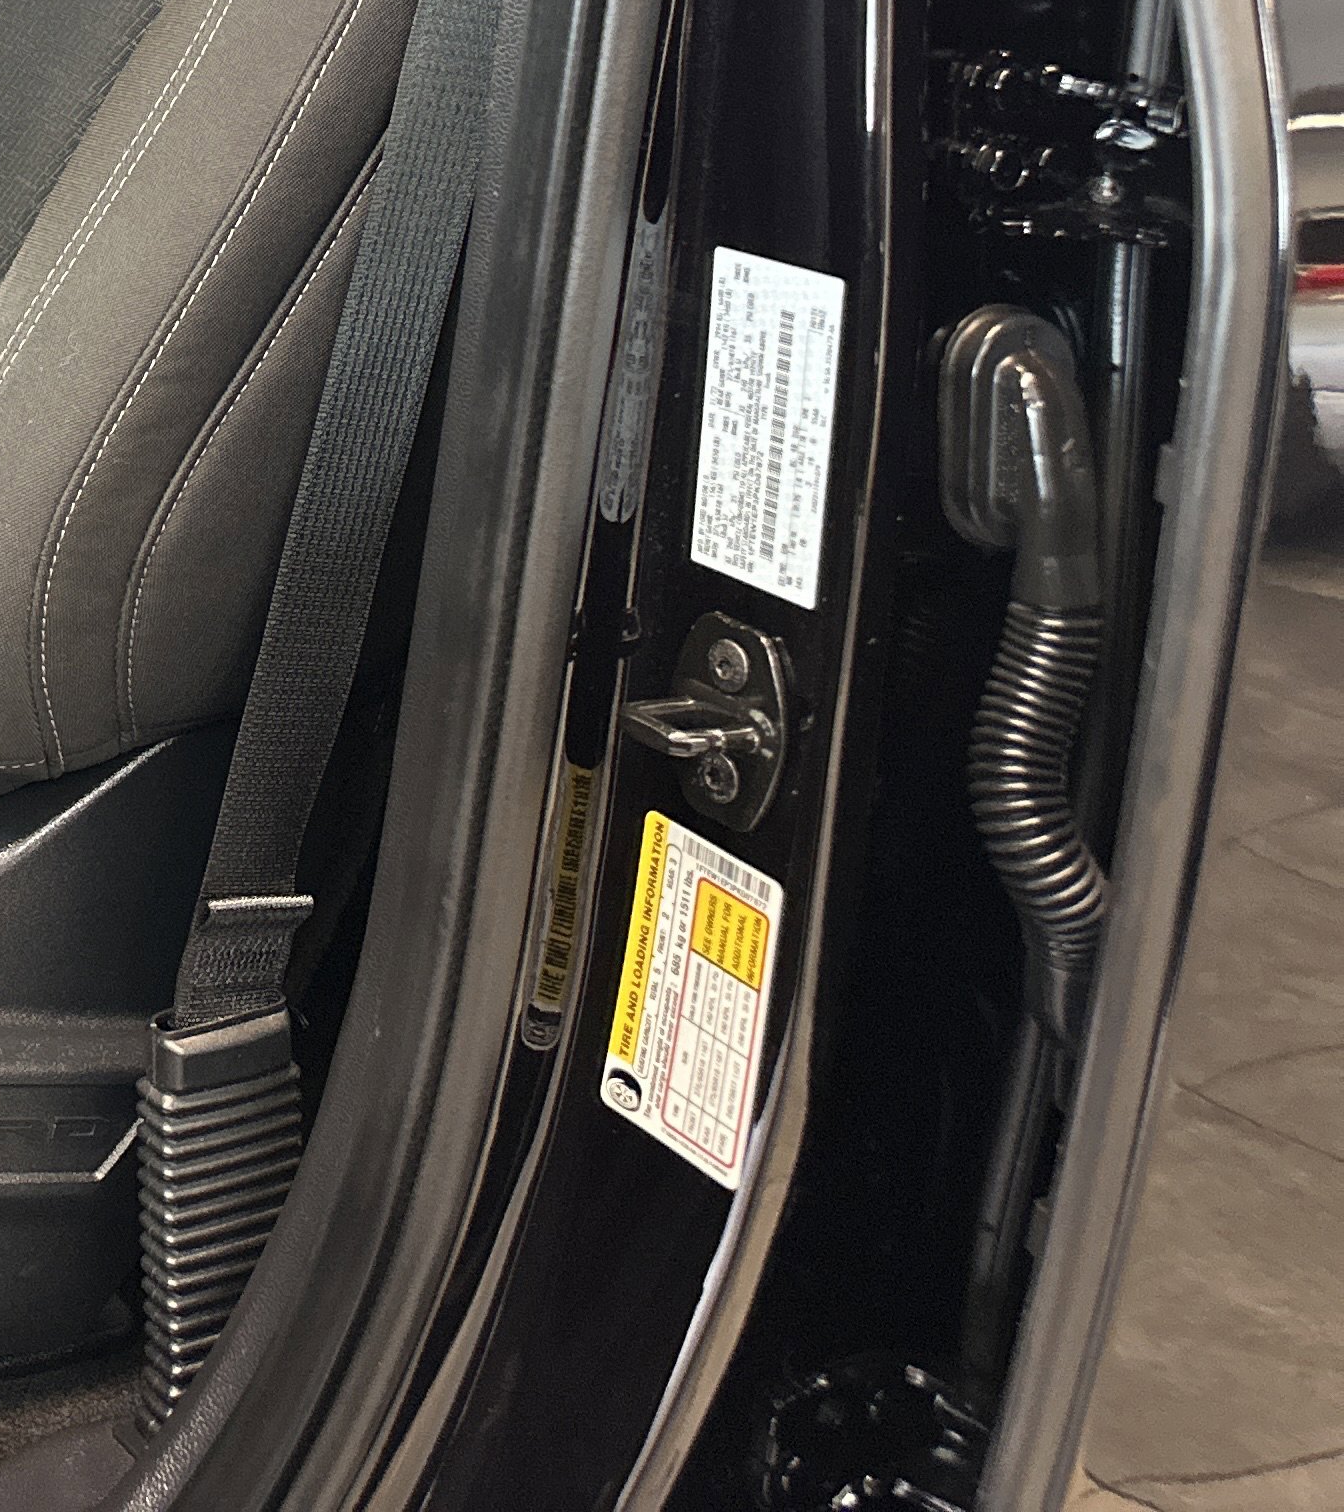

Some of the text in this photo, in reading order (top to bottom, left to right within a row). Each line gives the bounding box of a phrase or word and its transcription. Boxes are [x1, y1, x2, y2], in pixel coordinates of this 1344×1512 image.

[679, 888, 691, 918] 1511
[715, 900, 732, 965] MANUAL FOR
[618, 820, 665, 1059] TIRE AND LOADING INFORMATION
[674, 932, 686, 951] kg
[701, 934, 711, 956] SEE
[730, 911, 747, 972] ADDITIONAL
[744, 914, 762, 984] INFORMATION
